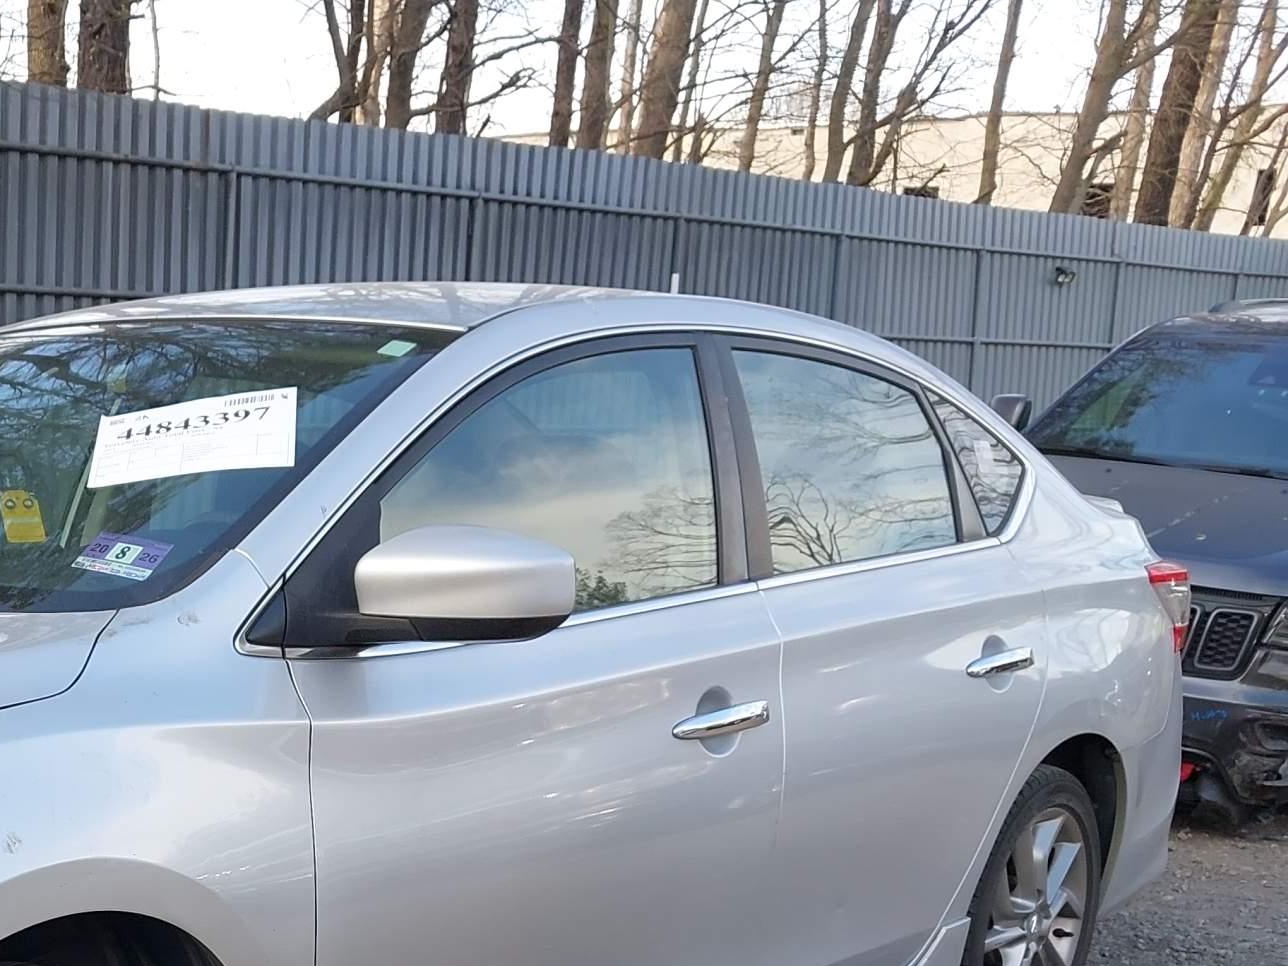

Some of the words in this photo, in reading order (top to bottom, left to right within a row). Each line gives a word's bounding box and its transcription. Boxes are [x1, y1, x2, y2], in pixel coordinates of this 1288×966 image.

[116, 406, 271, 441] 44843397
[90, 543, 110, 554] 20
[115, 546, 131, 559] 8
[139, 552, 160, 564] 26
